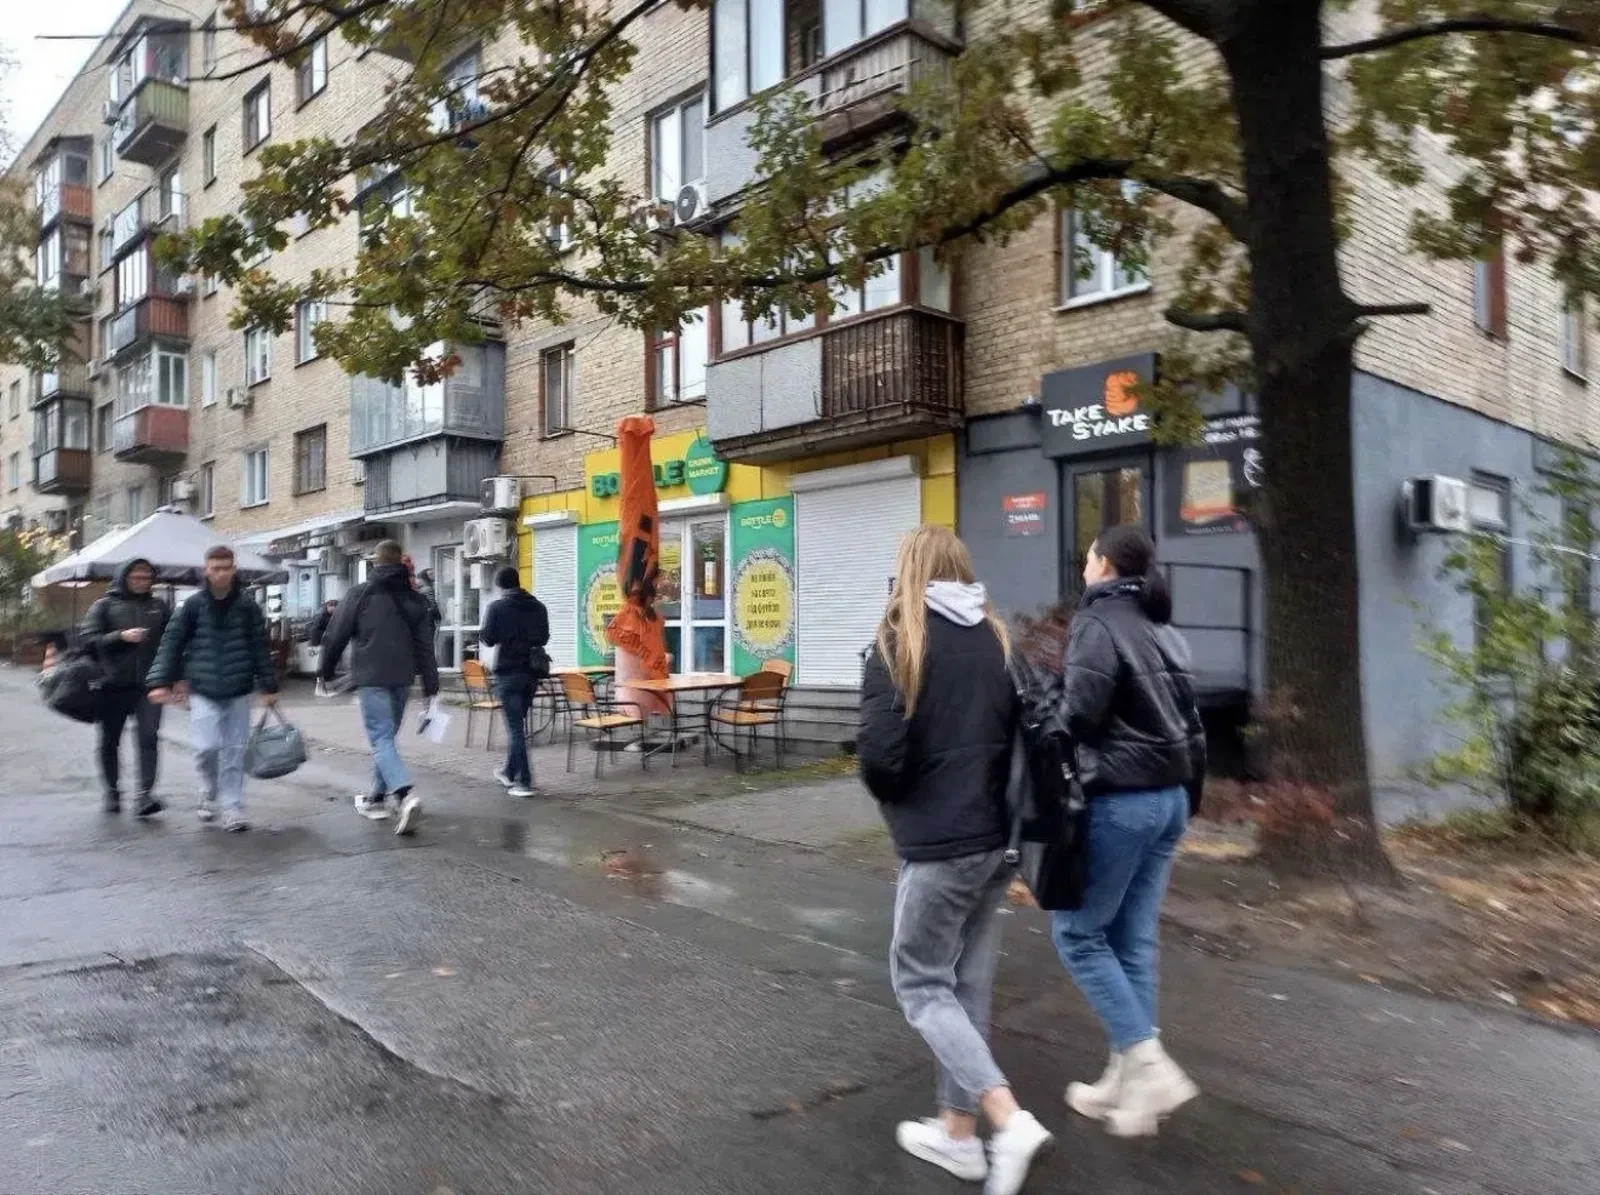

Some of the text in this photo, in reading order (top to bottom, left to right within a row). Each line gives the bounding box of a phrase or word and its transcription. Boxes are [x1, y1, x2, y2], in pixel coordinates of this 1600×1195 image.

[1046, 404, 1105, 427] TAKE
[592, 460, 686, 497] BOLE
[689, 466, 720, 478] MARKET
